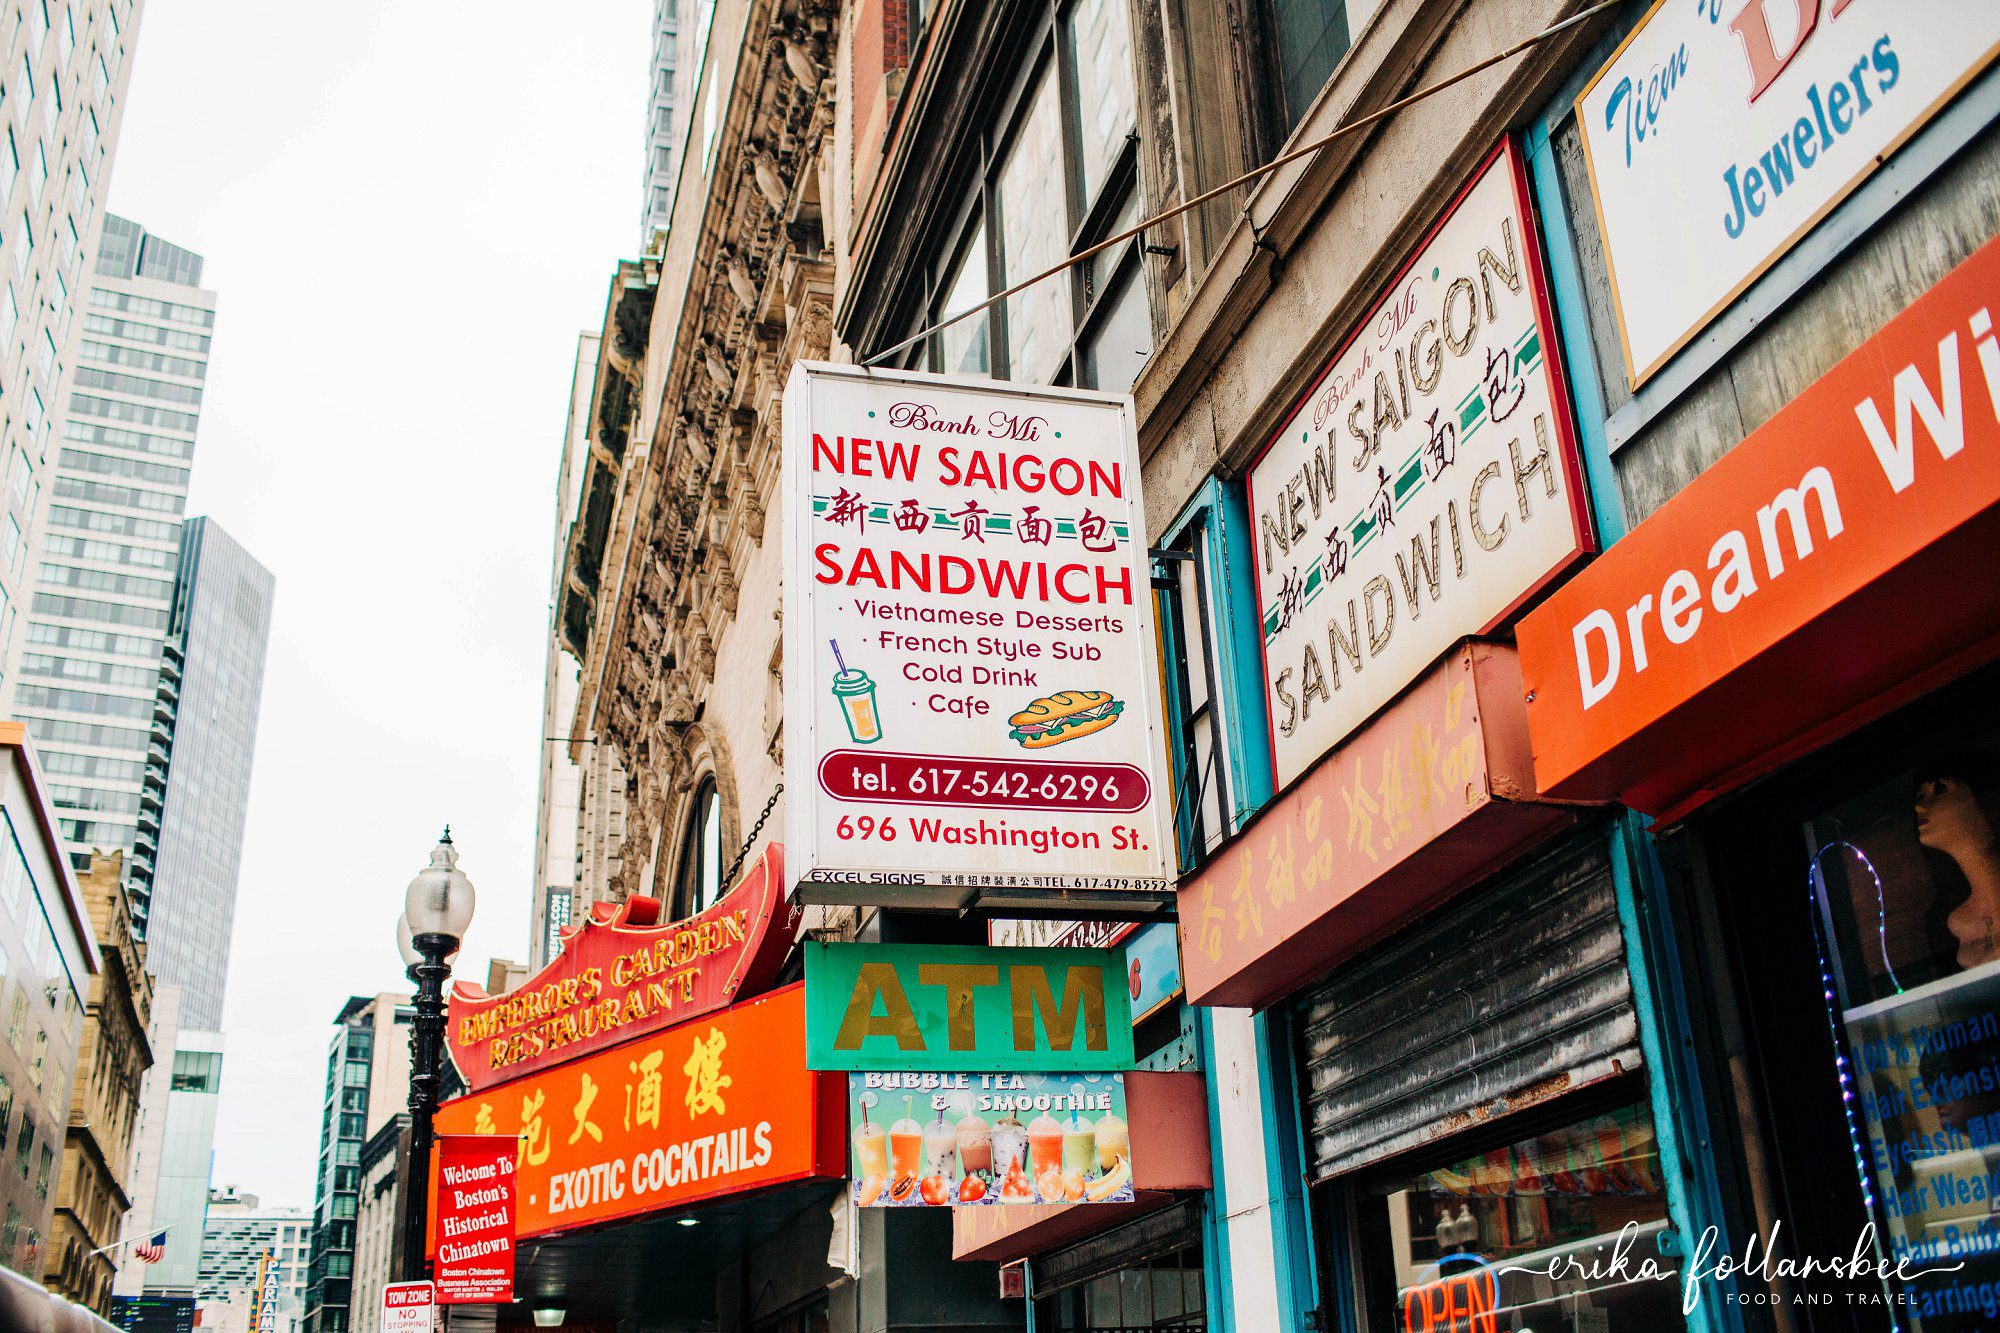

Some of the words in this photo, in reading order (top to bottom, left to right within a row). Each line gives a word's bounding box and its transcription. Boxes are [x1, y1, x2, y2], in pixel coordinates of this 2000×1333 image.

[1723, 33, 1901, 240] Jewelers
[1313, 347, 1374, 432] Banh
[1377, 276, 1423, 352] Mi
[1261, 427, 1337, 576] NEW
[1347, 216, 1523, 473] SAIGON
[888, 402, 981, 437] Banh
[987, 411, 1049, 442] Mi
[812, 433, 921, 482] NEW
[938, 446, 1123, 499] SAIGON
[813, 543, 1133, 605] SANDWICH
[1274, 412, 1560, 739] SANDWICH
[1571, 465, 1845, 712] Dream
[854, 599, 1005, 627] Vietnamese
[1015, 610, 1124, 634] Desserts
[878, 630, 968, 656] French
[977, 636, 1042, 662] Style
[1051, 641, 1102, 662] Sub
[902, 662, 963, 685] Cold
[972, 666, 1038, 688] Drink
[928, 693, 990, 719] Cafe
[852, 762, 897, 793] tel.
[908, 766, 1120, 802] 617-542-6296
[836, 814, 897, 842] 696
[909, 817, 1100, 854] Washington
[1111, 825, 1149, 852] St.
[811, 871, 866, 884] EXCEL
[870, 872, 926, 885] SIGNS
[1044, 876, 1070, 888] TEL.
[1074, 877, 1168, 891] 617-479-8552
[458, 966, 603, 1047] EMPEROR'S
[609, 909, 750, 988] GARDEN
[488, 967, 702, 1071] RESTAURANT
[832, 961, 1110, 1053] ATM
[1911, 1012, 1999, 1057] Human
[864, 1071, 970, 1090] BUBBLE
[978, 1072, 1027, 1091] TEA
[930, 1093, 951, 1111] &
[977, 1093, 1112, 1112] SMOOTHIE
[1860, 1082, 1907, 1124] Hair
[548, 1156, 625, 1214] EXOTIC
[631, 1120, 773, 1195] COCKTAILS
[1870, 1120, 1965, 1178] Eyelash
[442, 1163, 497, 1186] Welcome
[496, 1156, 514, 1175] To
[1881, 1178, 1929, 1218] Hair
[1930, 1160, 2000, 1210] Weav
[453, 1183, 509, 1210] Boston's
[442, 1206, 509, 1238] Historical
[439, 1236, 510, 1264] Chinatown
[1891, 1231, 1939, 1265] Hair
[437, 1279, 469, 1288] Business
[470, 1278, 511, 1287] Association
[441, 1268, 467, 1277] Boston
[467, 1267, 505, 1277] Chinatown
[260, 1260, 279, 1333] PARAM
[388, 1291, 407, 1305] TOW
[407, 1289, 430, 1304] ZONE
[398, 1309, 417, 1319] NO
[1404, 1268, 1497, 1333] OPEN
[387, 1320, 428, 1330] STOPPING
